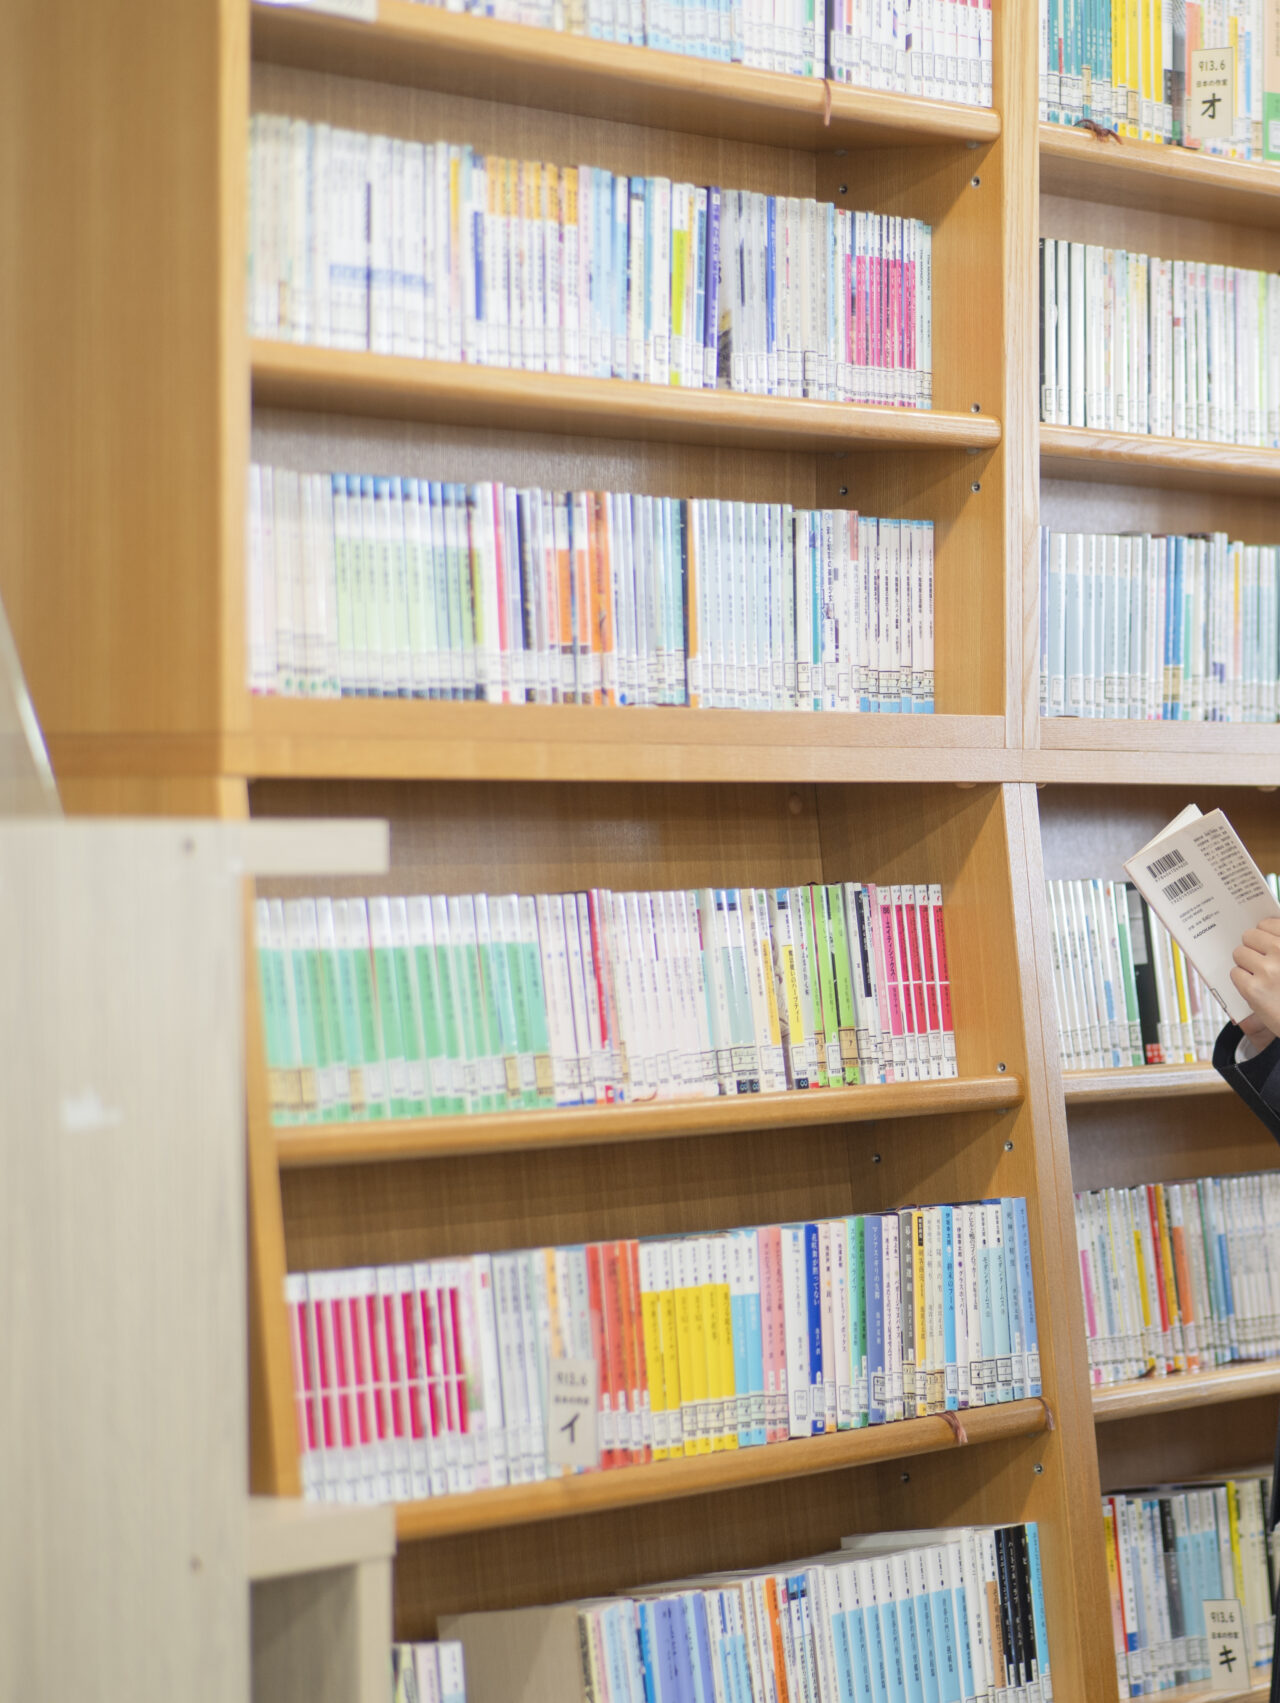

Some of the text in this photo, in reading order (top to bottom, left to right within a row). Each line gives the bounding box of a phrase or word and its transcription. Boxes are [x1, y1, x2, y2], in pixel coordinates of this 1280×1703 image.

[1198, 60, 1226, 72] 913.6
[1196, 79, 1228, 88] 日本の作家
[1201, 93, 1222, 119] オ
[1193, 923, 1217, 939] KADOKAWA
[560, 1411, 580, 1443] イ
[1210, 1611, 1235, 1623] 913.6
[1219, 1645, 1237, 1672] キ
